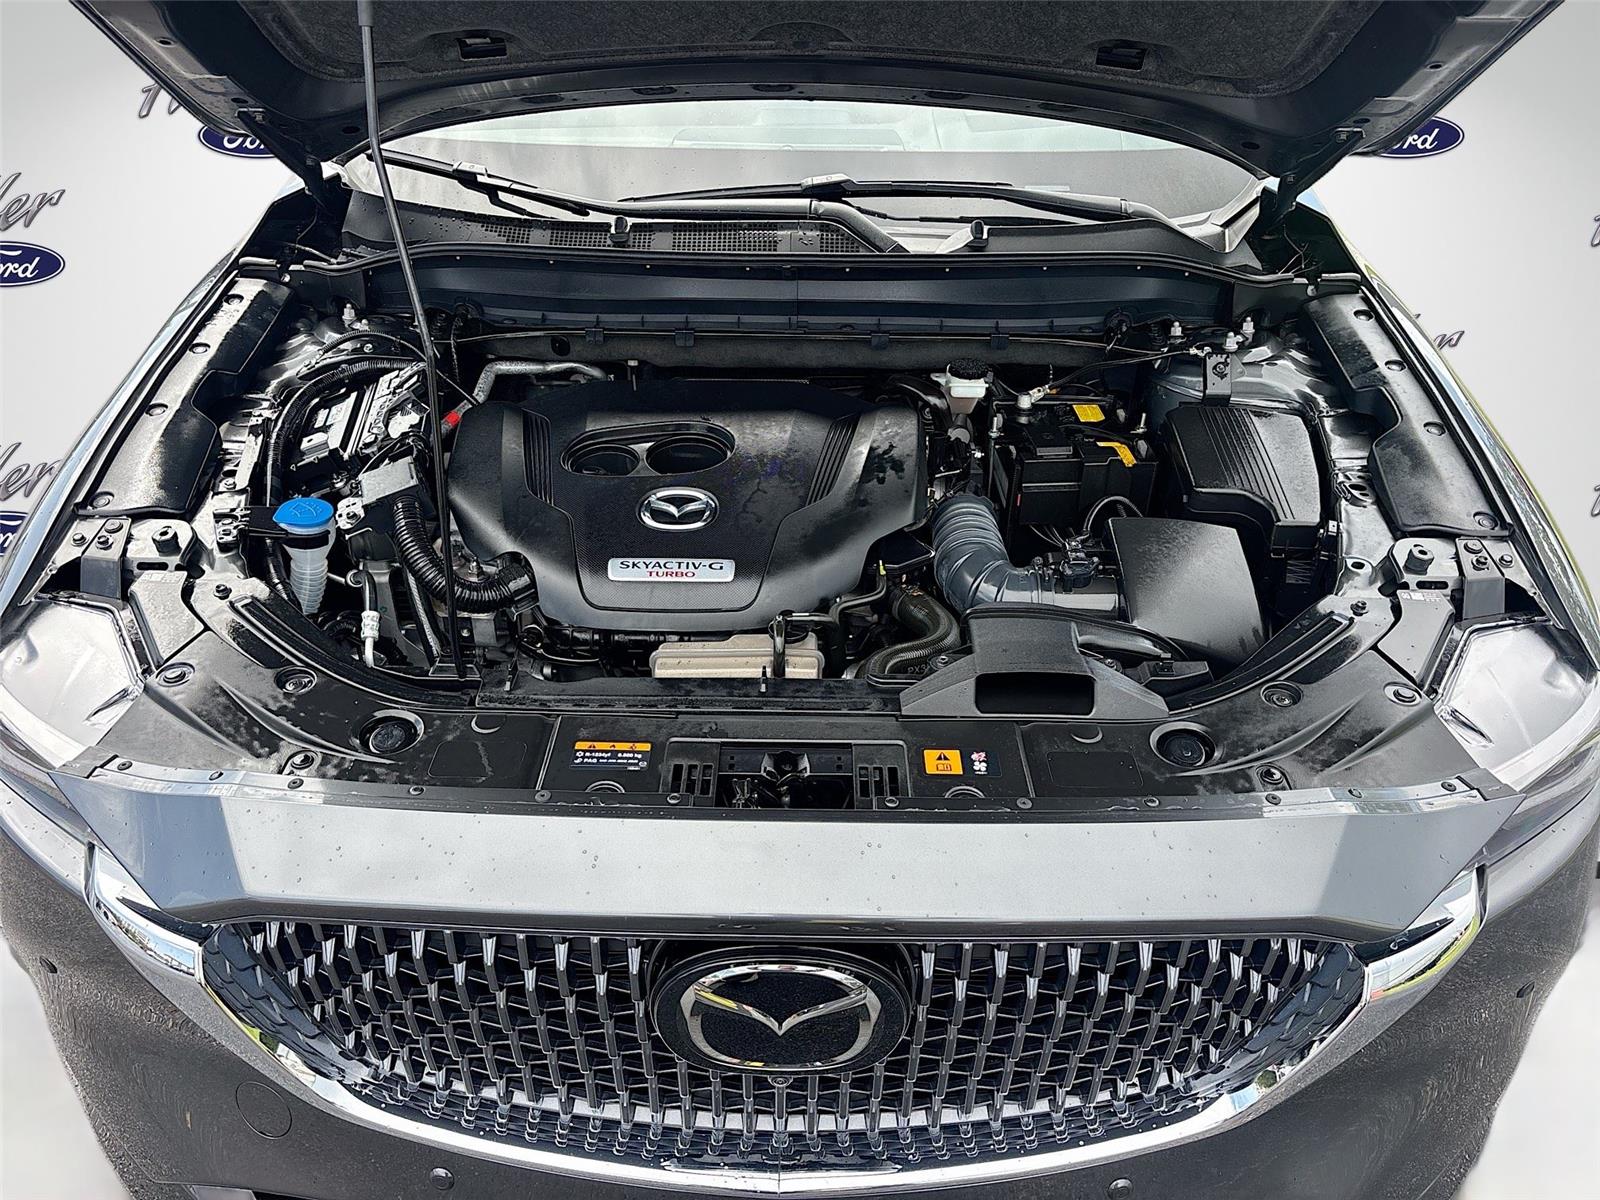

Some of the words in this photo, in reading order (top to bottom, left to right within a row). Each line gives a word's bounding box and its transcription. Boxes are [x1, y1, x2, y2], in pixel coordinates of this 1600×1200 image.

[1393, 128, 1439, 149] rd
[619, 560, 724, 571] SKYACTIV-G
[647, 570, 696, 578] TURBO
